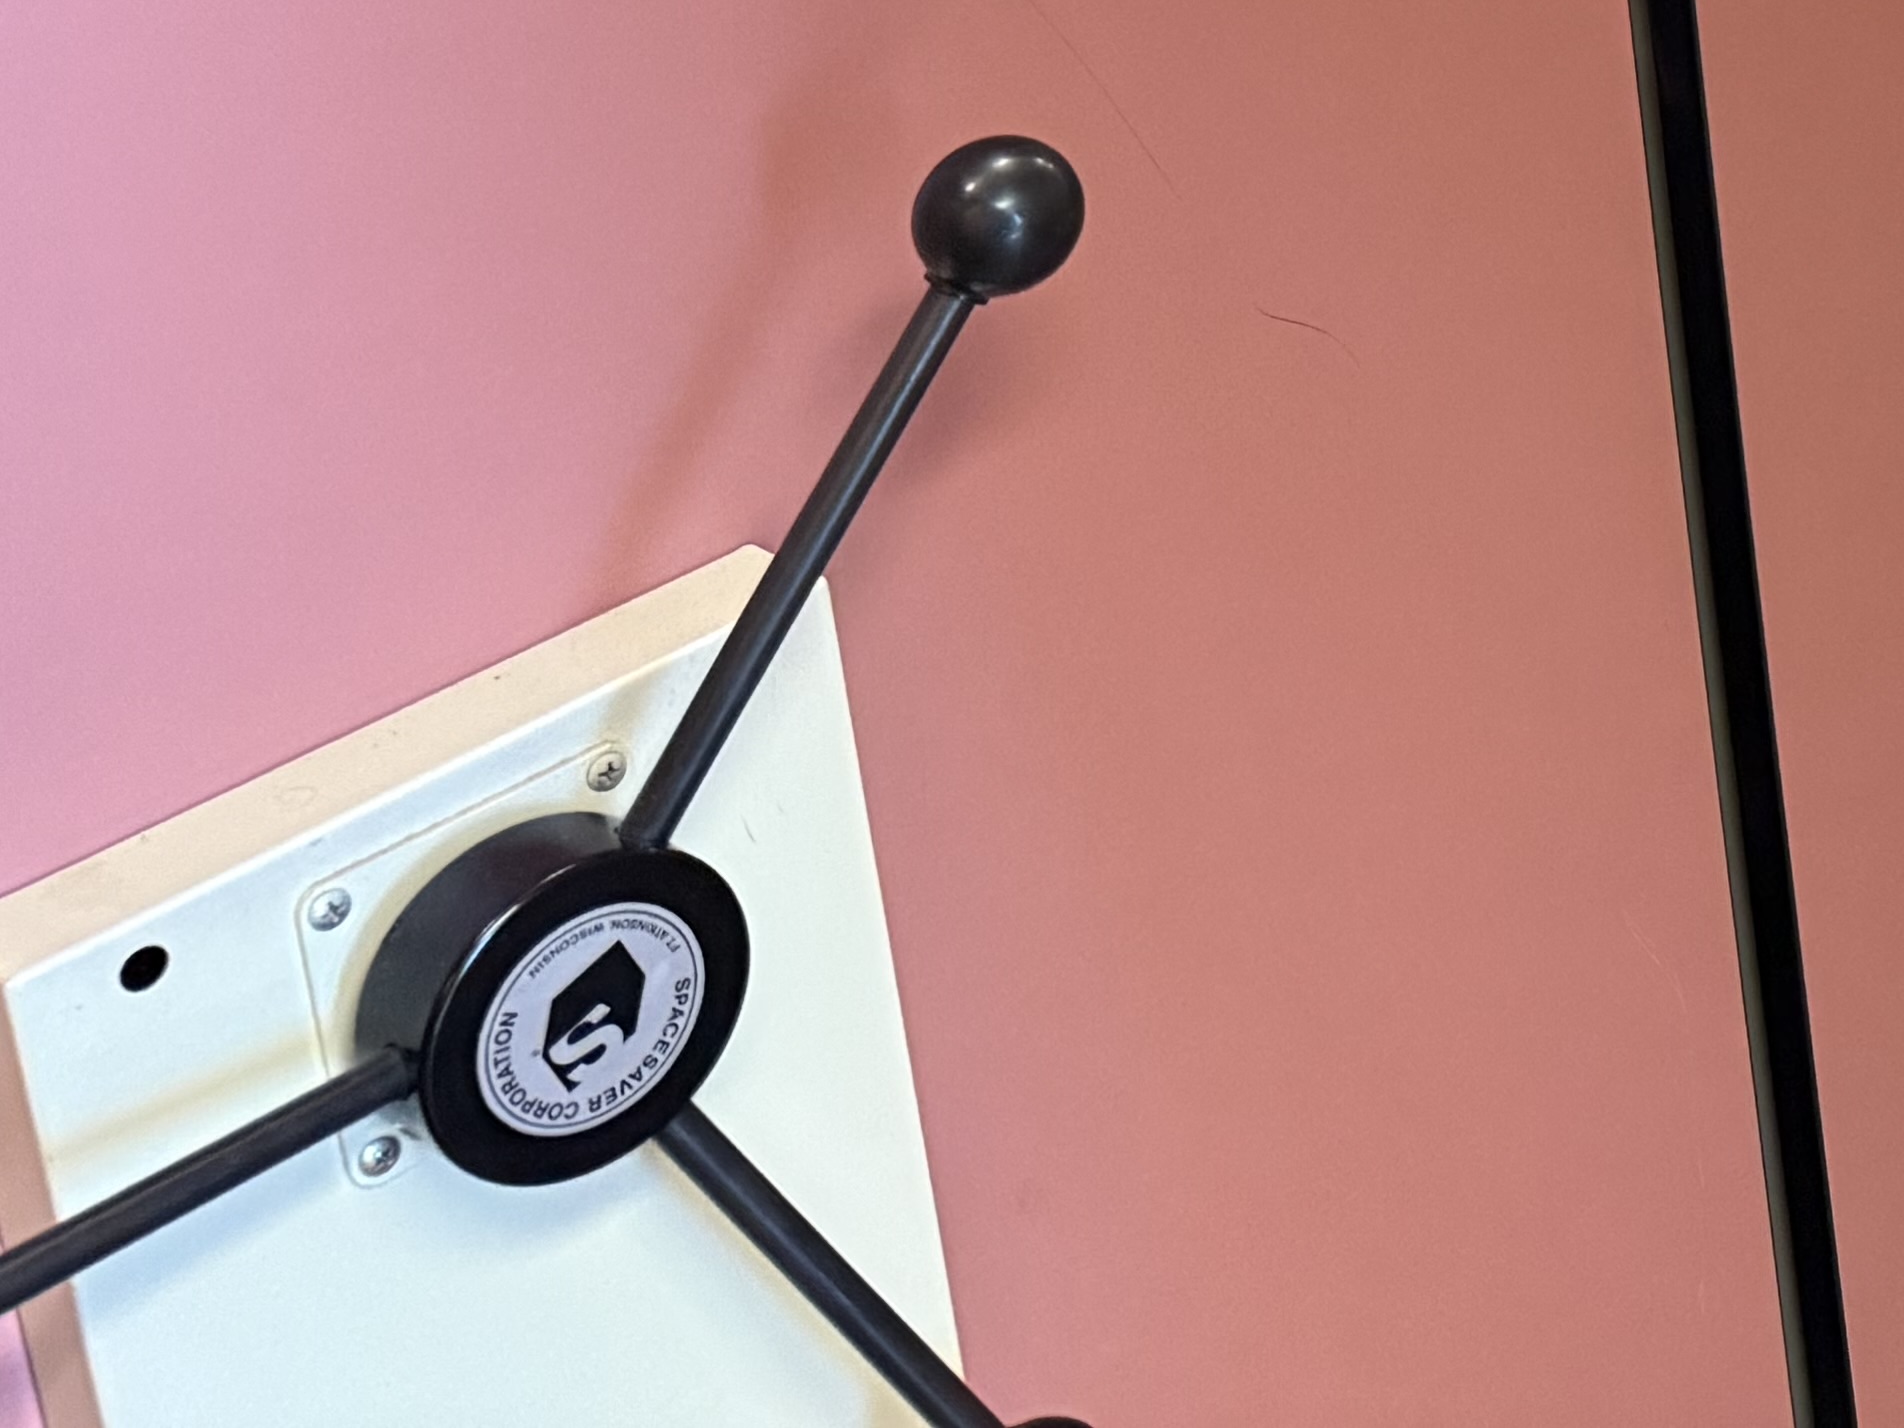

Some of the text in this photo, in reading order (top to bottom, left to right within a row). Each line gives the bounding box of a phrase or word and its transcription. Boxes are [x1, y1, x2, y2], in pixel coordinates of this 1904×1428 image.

[528, 923, 605, 980] WISCONSIN
[493, 977, 691, 1121] SPACESAVER CORPORATION
